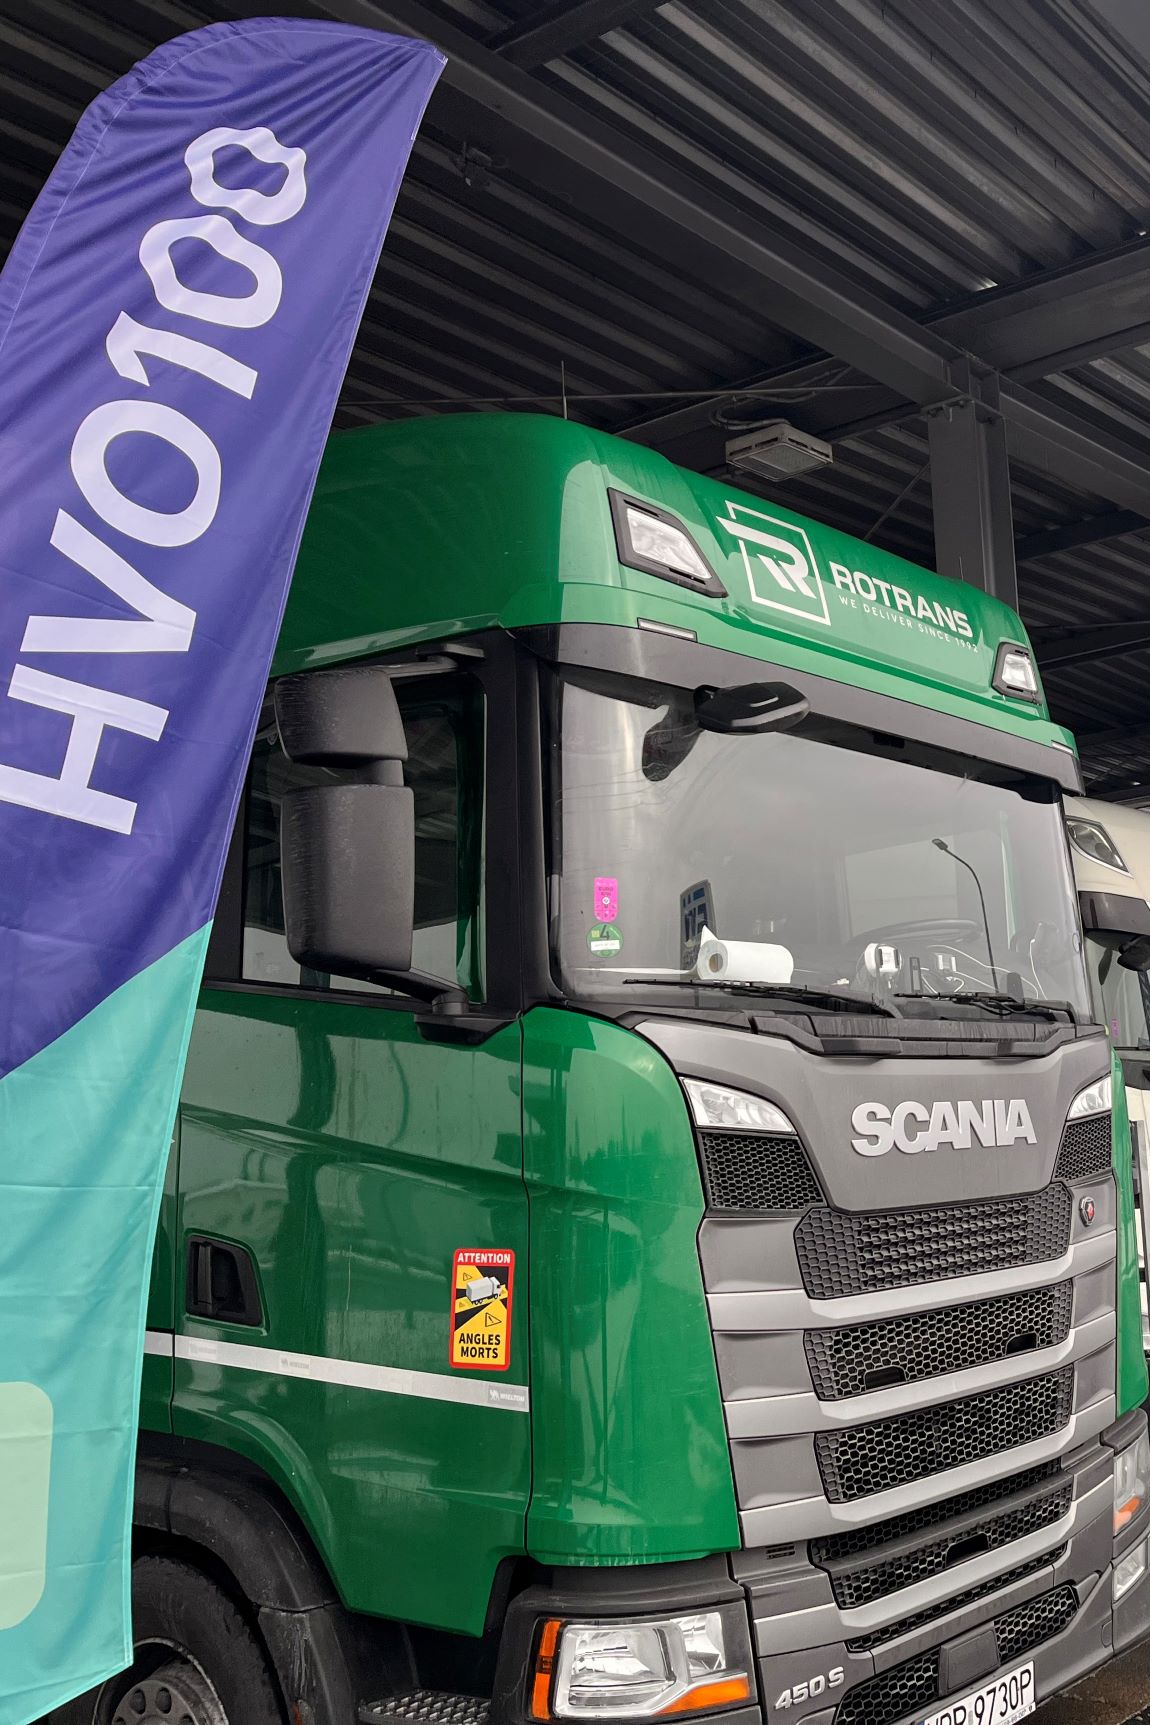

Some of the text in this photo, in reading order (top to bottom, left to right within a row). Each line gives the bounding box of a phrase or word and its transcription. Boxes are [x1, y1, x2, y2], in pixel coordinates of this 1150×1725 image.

[0, 126, 307, 836] HVO100
[829, 561, 974, 638] ROTRANS
[839, 594, 979, 653] WE DELIVER SINCE 1992
[851, 1099, 1038, 1157] SCANIA
[457, 1252, 511, 1264] ATTENTION
[459, 1332, 501, 1346] ANGLES
[460, 1347, 499, 1359] MORTS
[775, 1666, 845, 1710] 450 S
[974, 1668, 1032, 1725] 9730P
